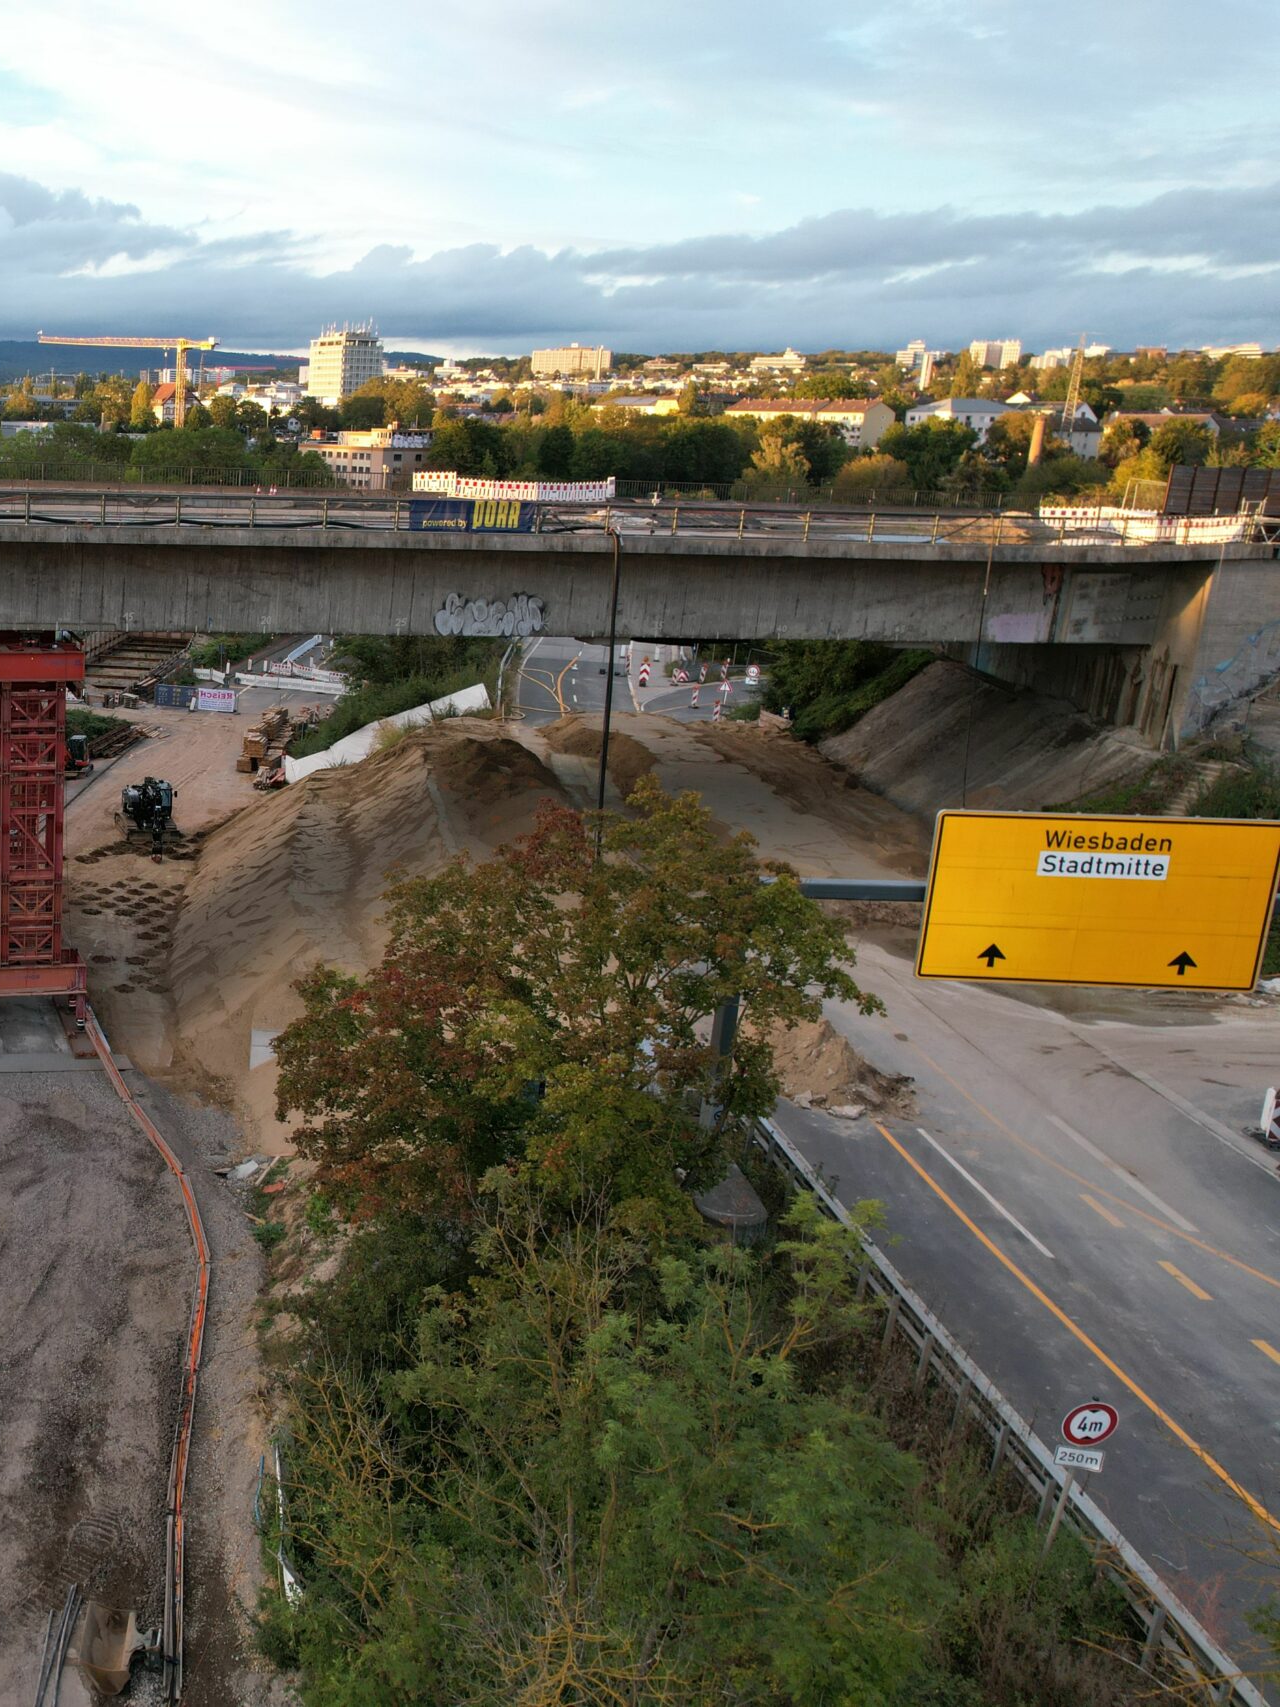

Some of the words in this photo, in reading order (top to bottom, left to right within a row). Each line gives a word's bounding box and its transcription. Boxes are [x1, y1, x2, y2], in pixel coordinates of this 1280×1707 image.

[422, 518, 456, 529] powered
[457, 518, 468, 529] by
[1045, 829, 1172, 852] Wiesbaden
[1041, 855, 1165, 877] Stadtmitte
[1077, 1416, 1103, 1432] 4m
